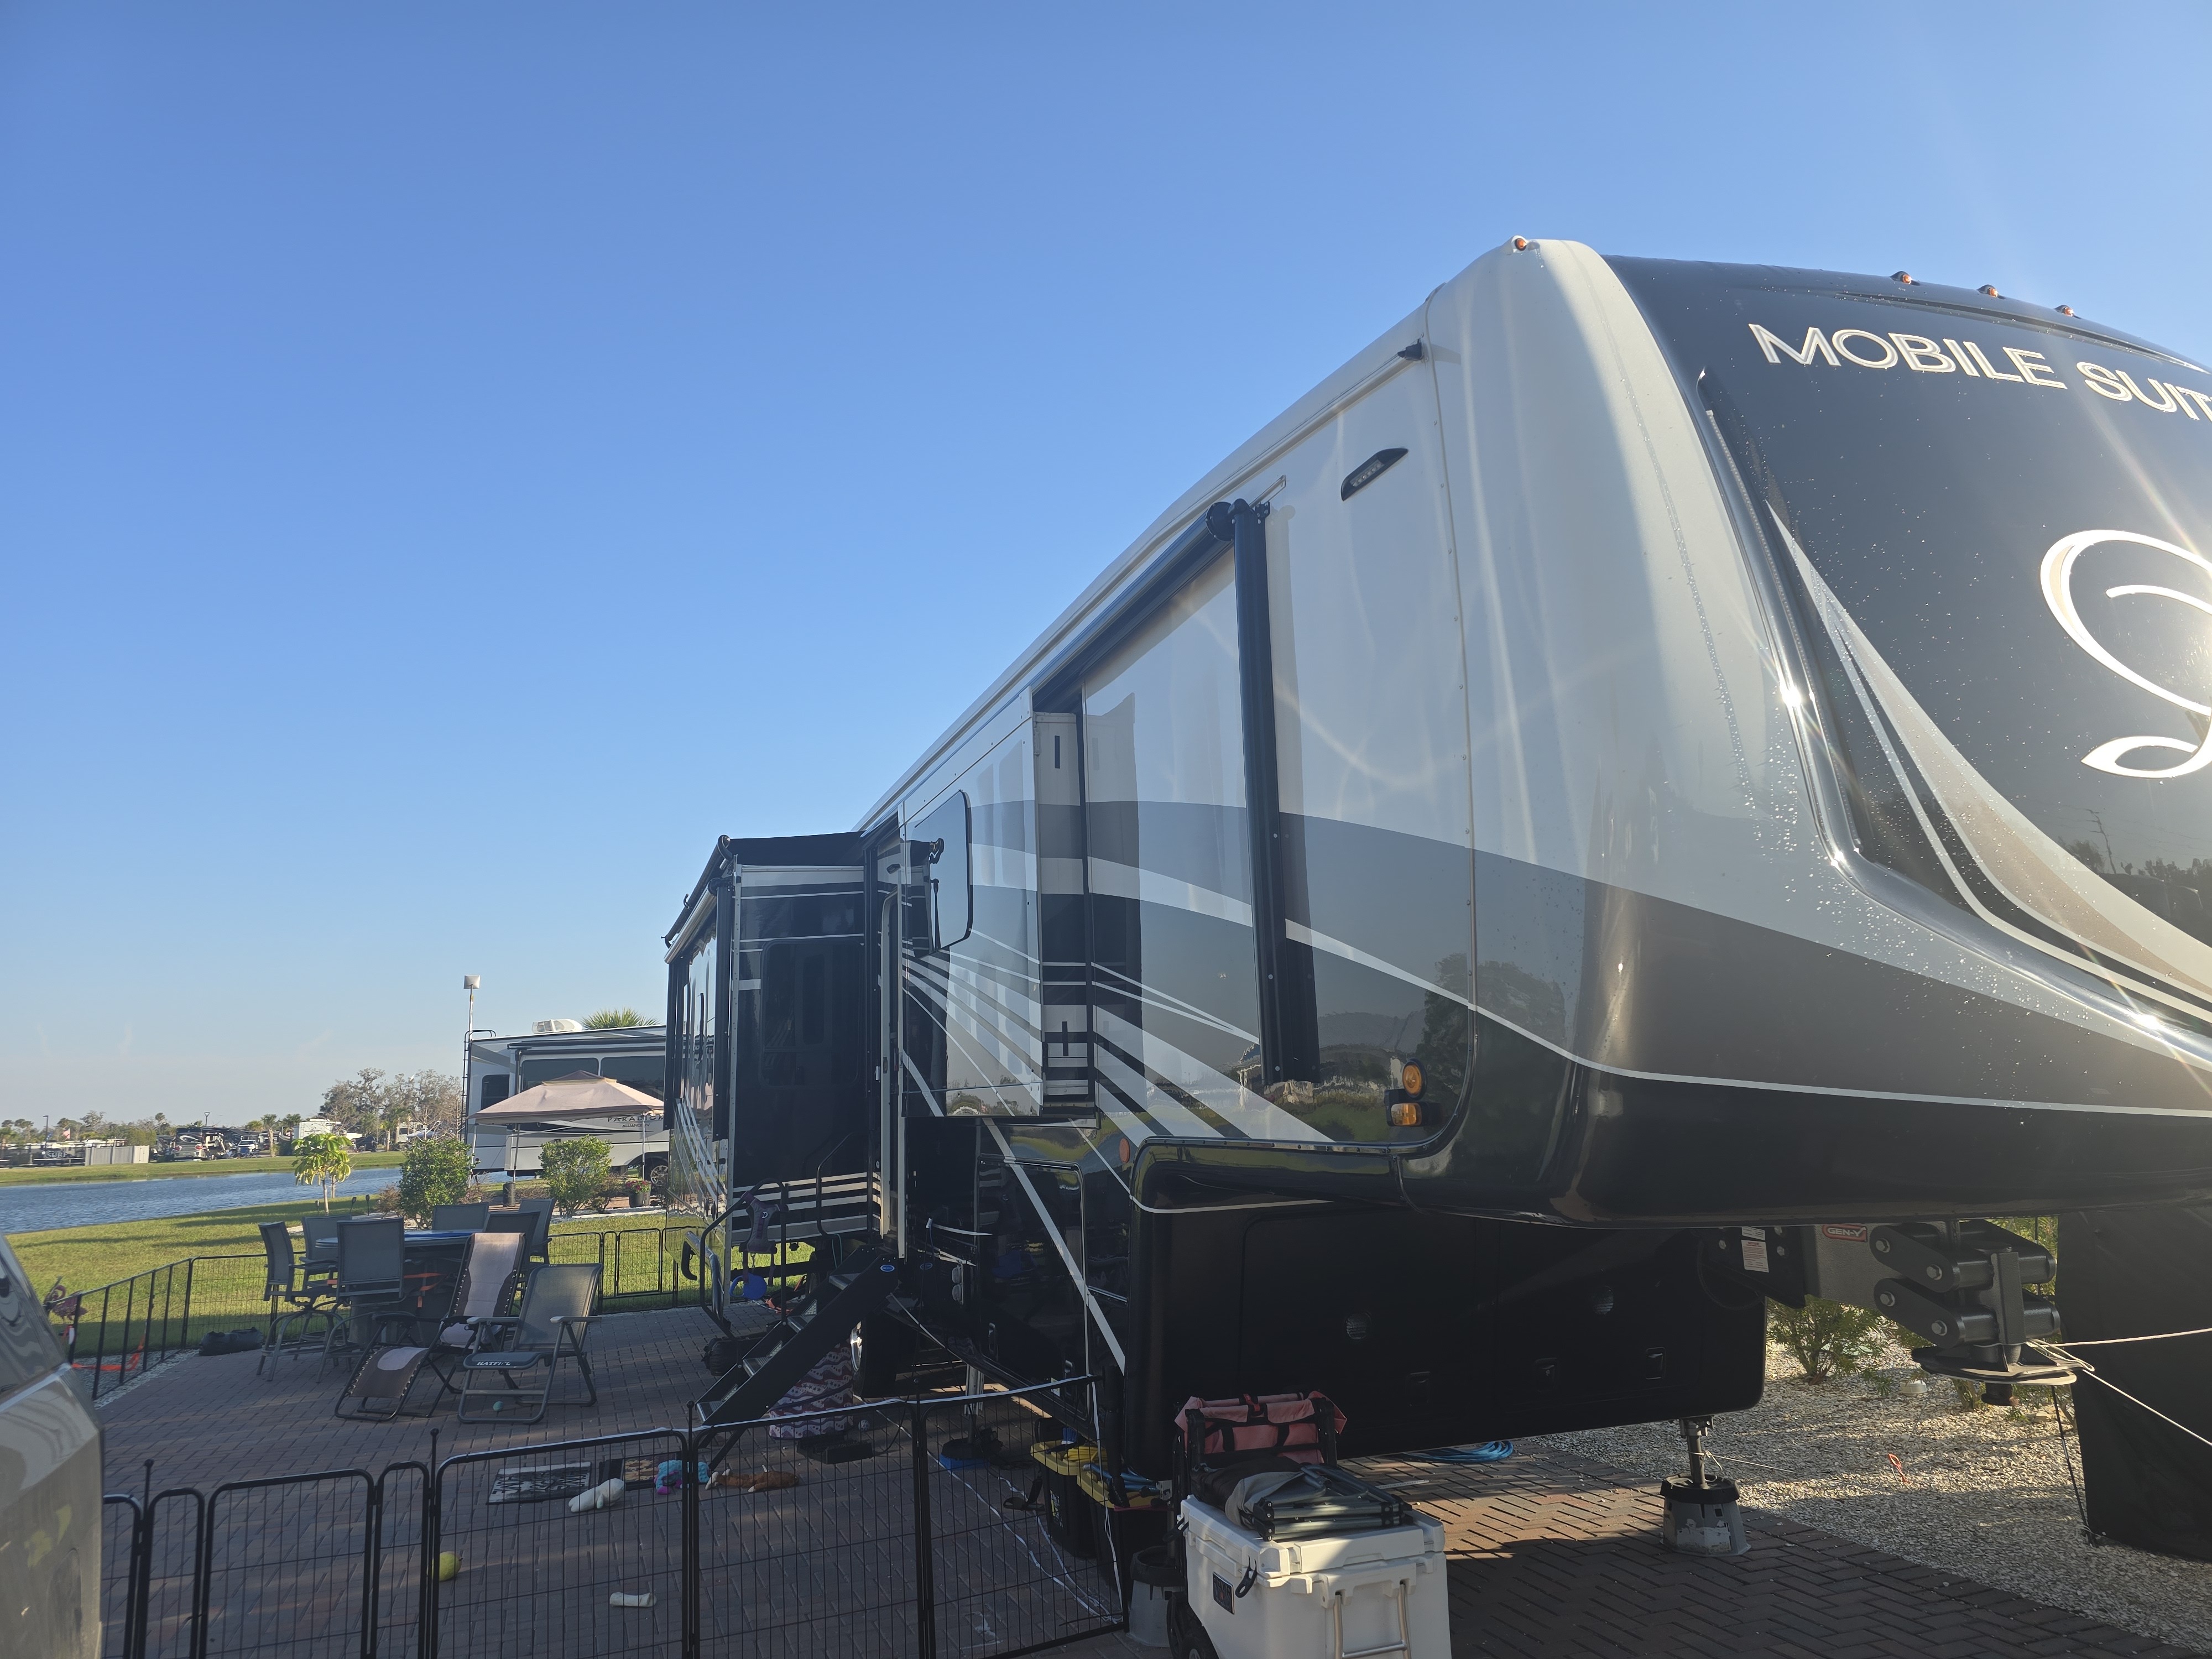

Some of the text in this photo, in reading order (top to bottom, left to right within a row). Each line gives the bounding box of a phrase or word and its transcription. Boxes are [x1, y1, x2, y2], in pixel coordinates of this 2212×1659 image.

[1748, 324, 2212, 422] MOBILE SUIT
[1827, 1227, 1866, 1237] GEN-Y
